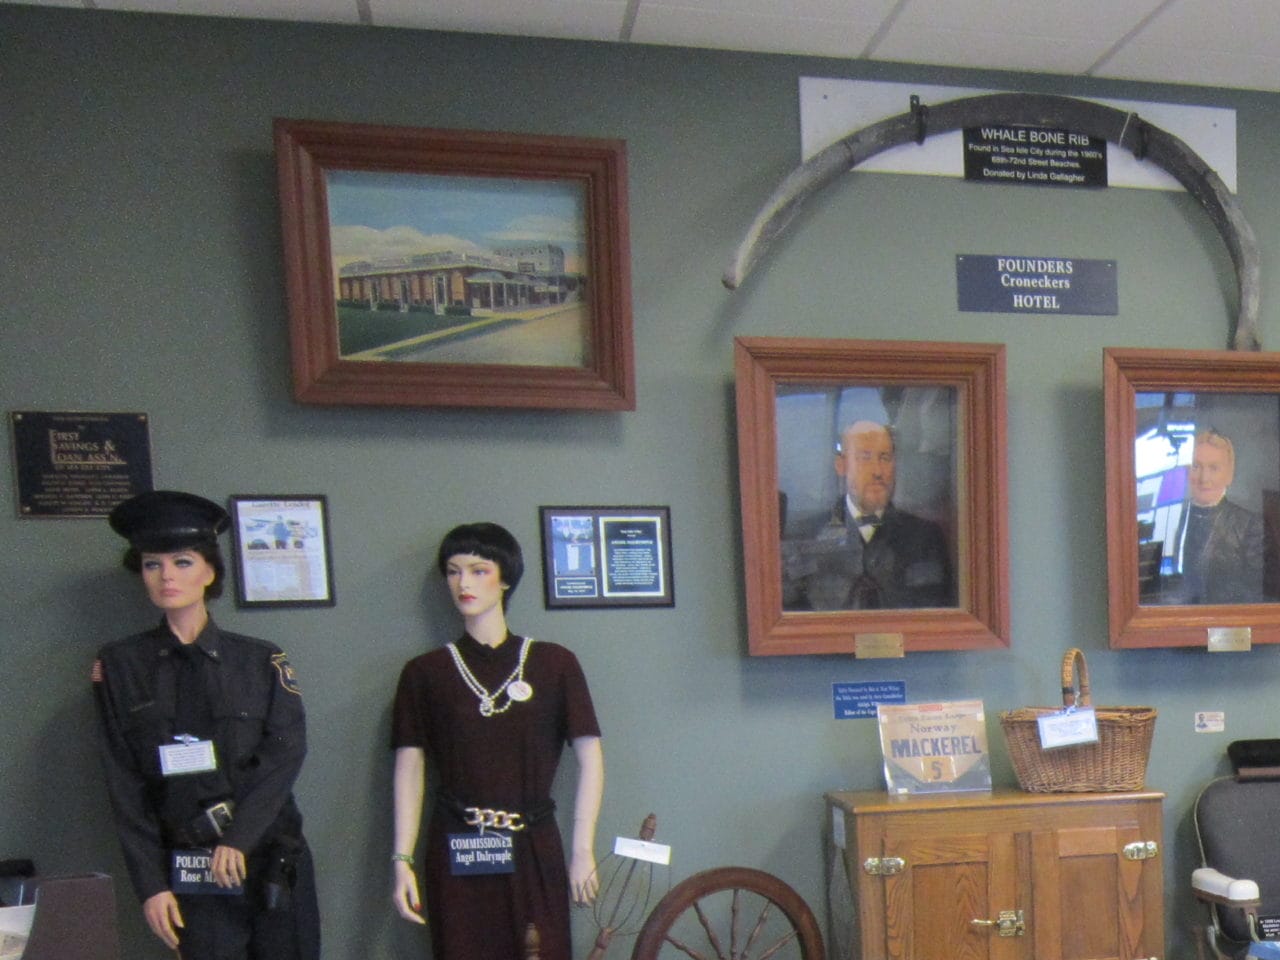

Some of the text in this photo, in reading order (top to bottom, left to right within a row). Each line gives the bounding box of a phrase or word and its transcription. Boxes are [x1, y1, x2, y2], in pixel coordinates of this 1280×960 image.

[981, 128, 1089, 146] WHALE BONE RIB
[968, 143, 991, 151] Found
[1030, 148, 1043, 157] City
[1045, 149, 1066, 158] during
[1028, 157, 1048, 166] Street
[983, 168, 1085, 183] Donated by Linda Gallagher
[998, 258, 1073, 274] FOUNDERS
[1001, 274, 1070, 288] Croneckers
[1013, 294, 1060, 309] HOTEL
[911, 723, 957, 734] Norway
[891, 735, 982, 759] MACKEREL
[451, 837, 512, 849] COMMISSIONER
[456, 850, 512, 866] Angel Dalrymple
[181, 870, 201, 882] Rose
